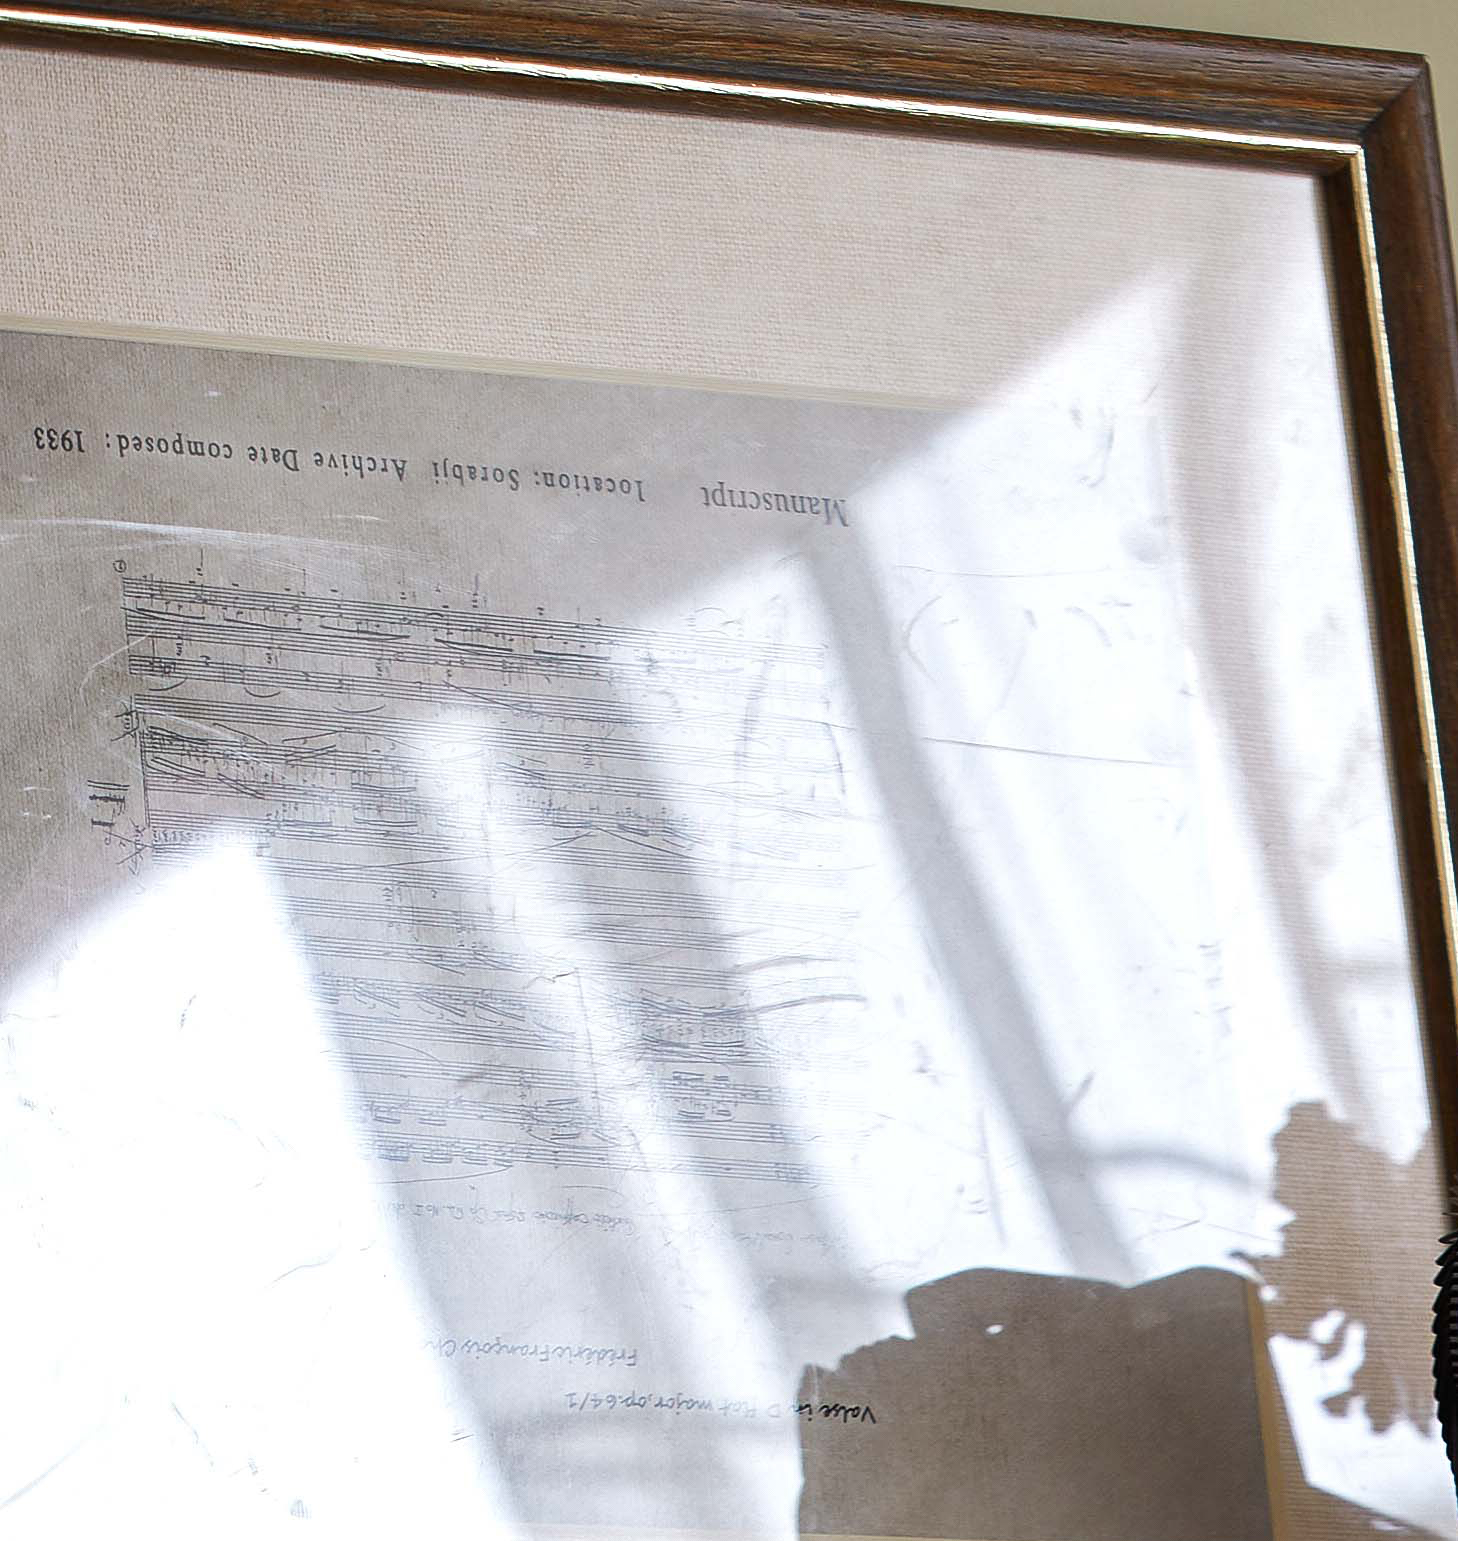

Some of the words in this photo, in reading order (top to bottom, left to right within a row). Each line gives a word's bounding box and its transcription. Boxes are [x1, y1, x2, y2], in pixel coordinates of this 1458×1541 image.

[33, 426, 86, 454] 1933
[104, 431, 233, 459] composed:
[247, 444, 300, 472] Date
[313, 451, 408, 482] Archive
[432, 458, 520, 492] Sorabji
[534, 470, 646, 502] location:
[701, 480, 849, 528] Manuscript
[818, 1403, 877, 1424] Valse
